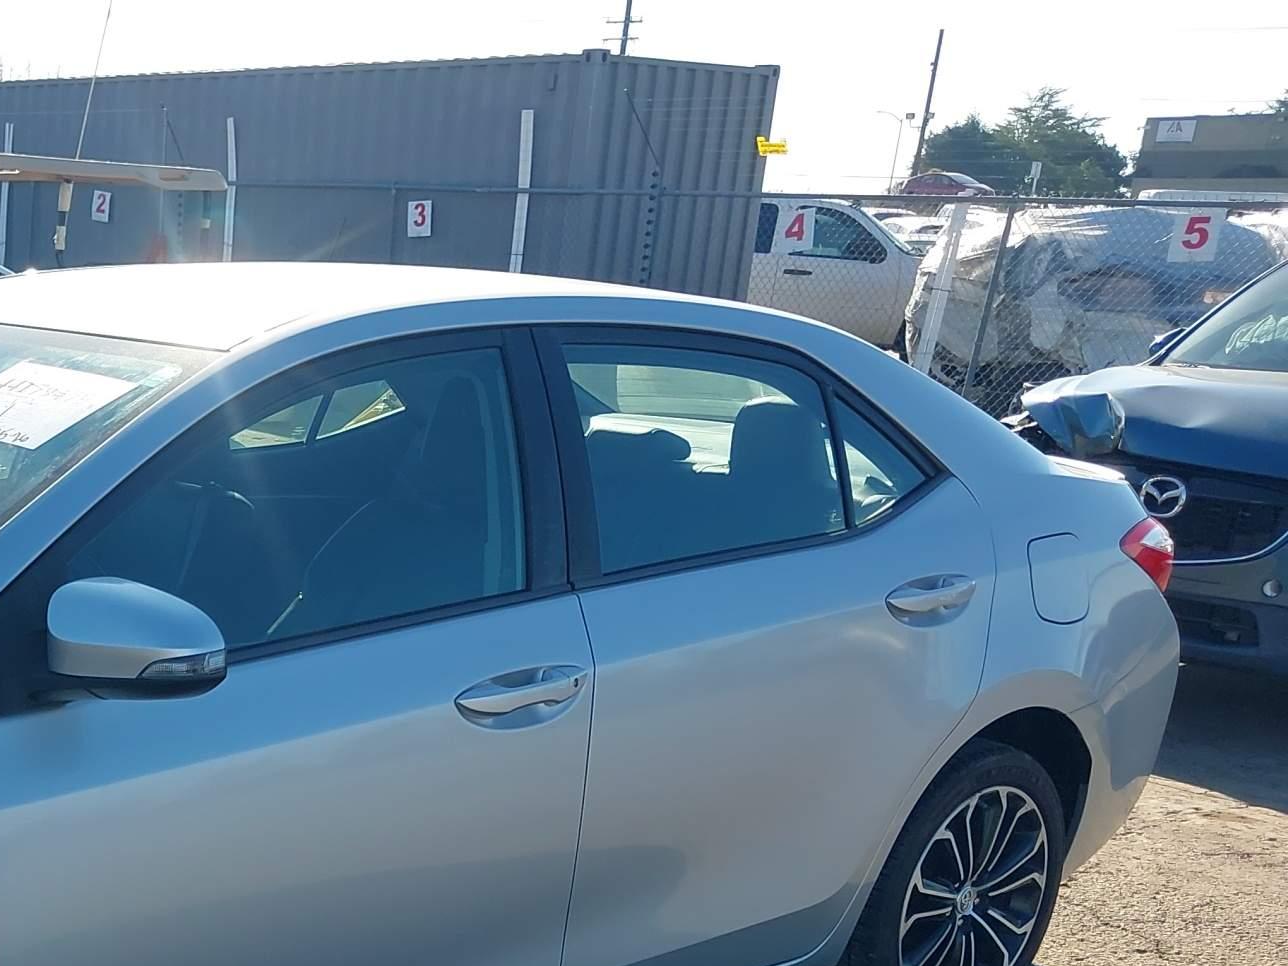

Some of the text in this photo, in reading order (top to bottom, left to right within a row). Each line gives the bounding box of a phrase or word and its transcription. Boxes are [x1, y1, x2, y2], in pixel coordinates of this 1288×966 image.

[96, 193, 106, 214] 2
[414, 202, 426, 228] 3
[784, 212, 805, 241] 4
[1181, 215, 1212, 250] 5
